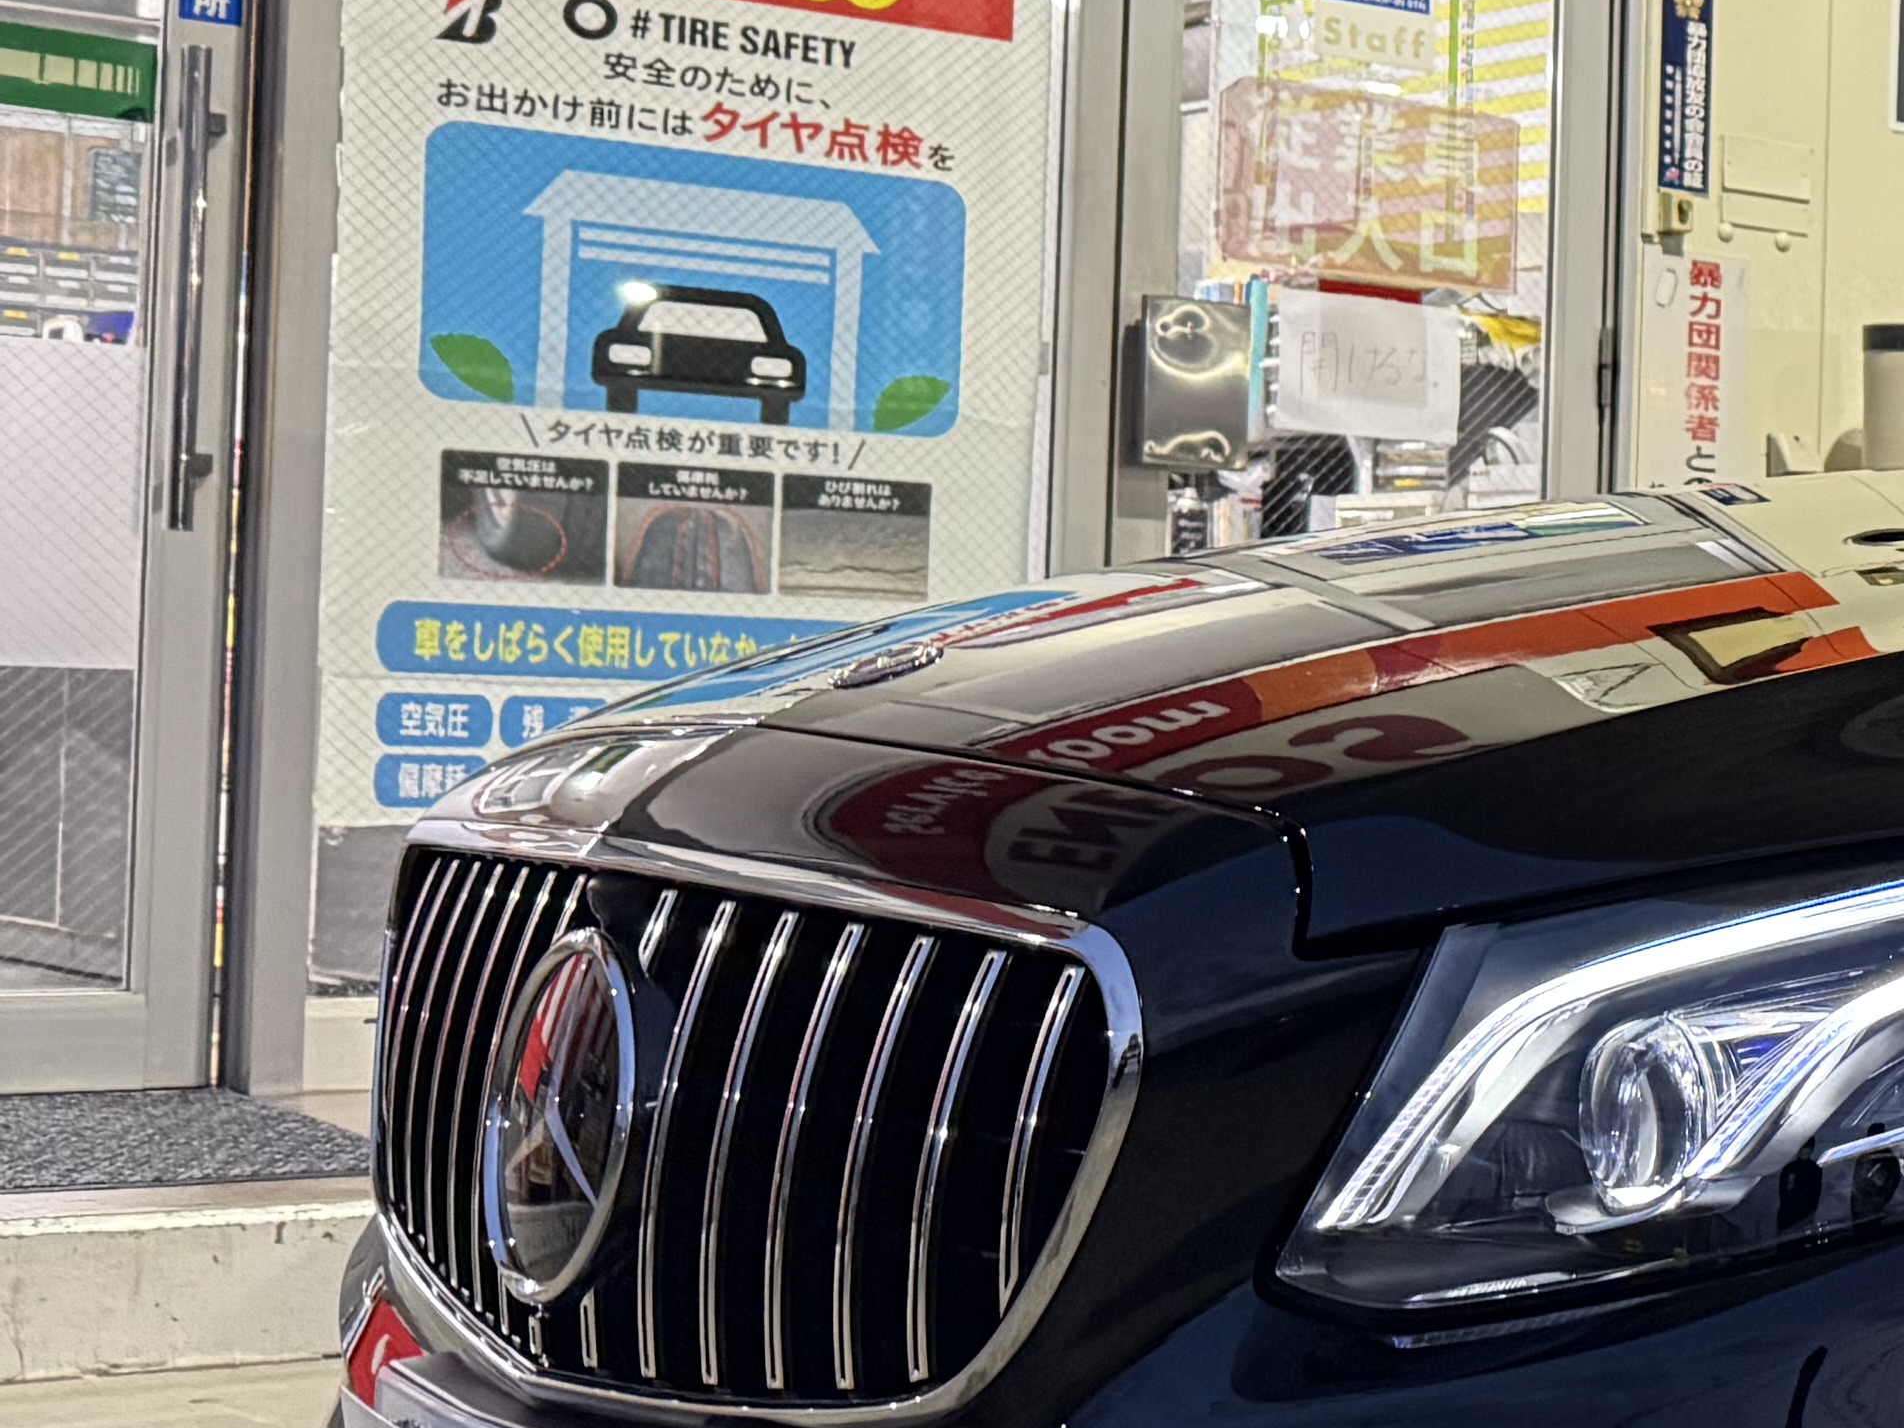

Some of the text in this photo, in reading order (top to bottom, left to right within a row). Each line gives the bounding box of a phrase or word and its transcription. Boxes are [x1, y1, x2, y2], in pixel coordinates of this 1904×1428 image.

[741, 21, 856, 68] SAFETY
[1323, 16, 1425, 60] Staff
[436, 78, 955, 172] お出かけ前にはタイヤ点検を
[1684, 259, 1723, 486] 暴力団関係者と
[414, 618, 799, 669] 車をしばらく使用していなか
[400, 701, 470, 739] 空気圧
